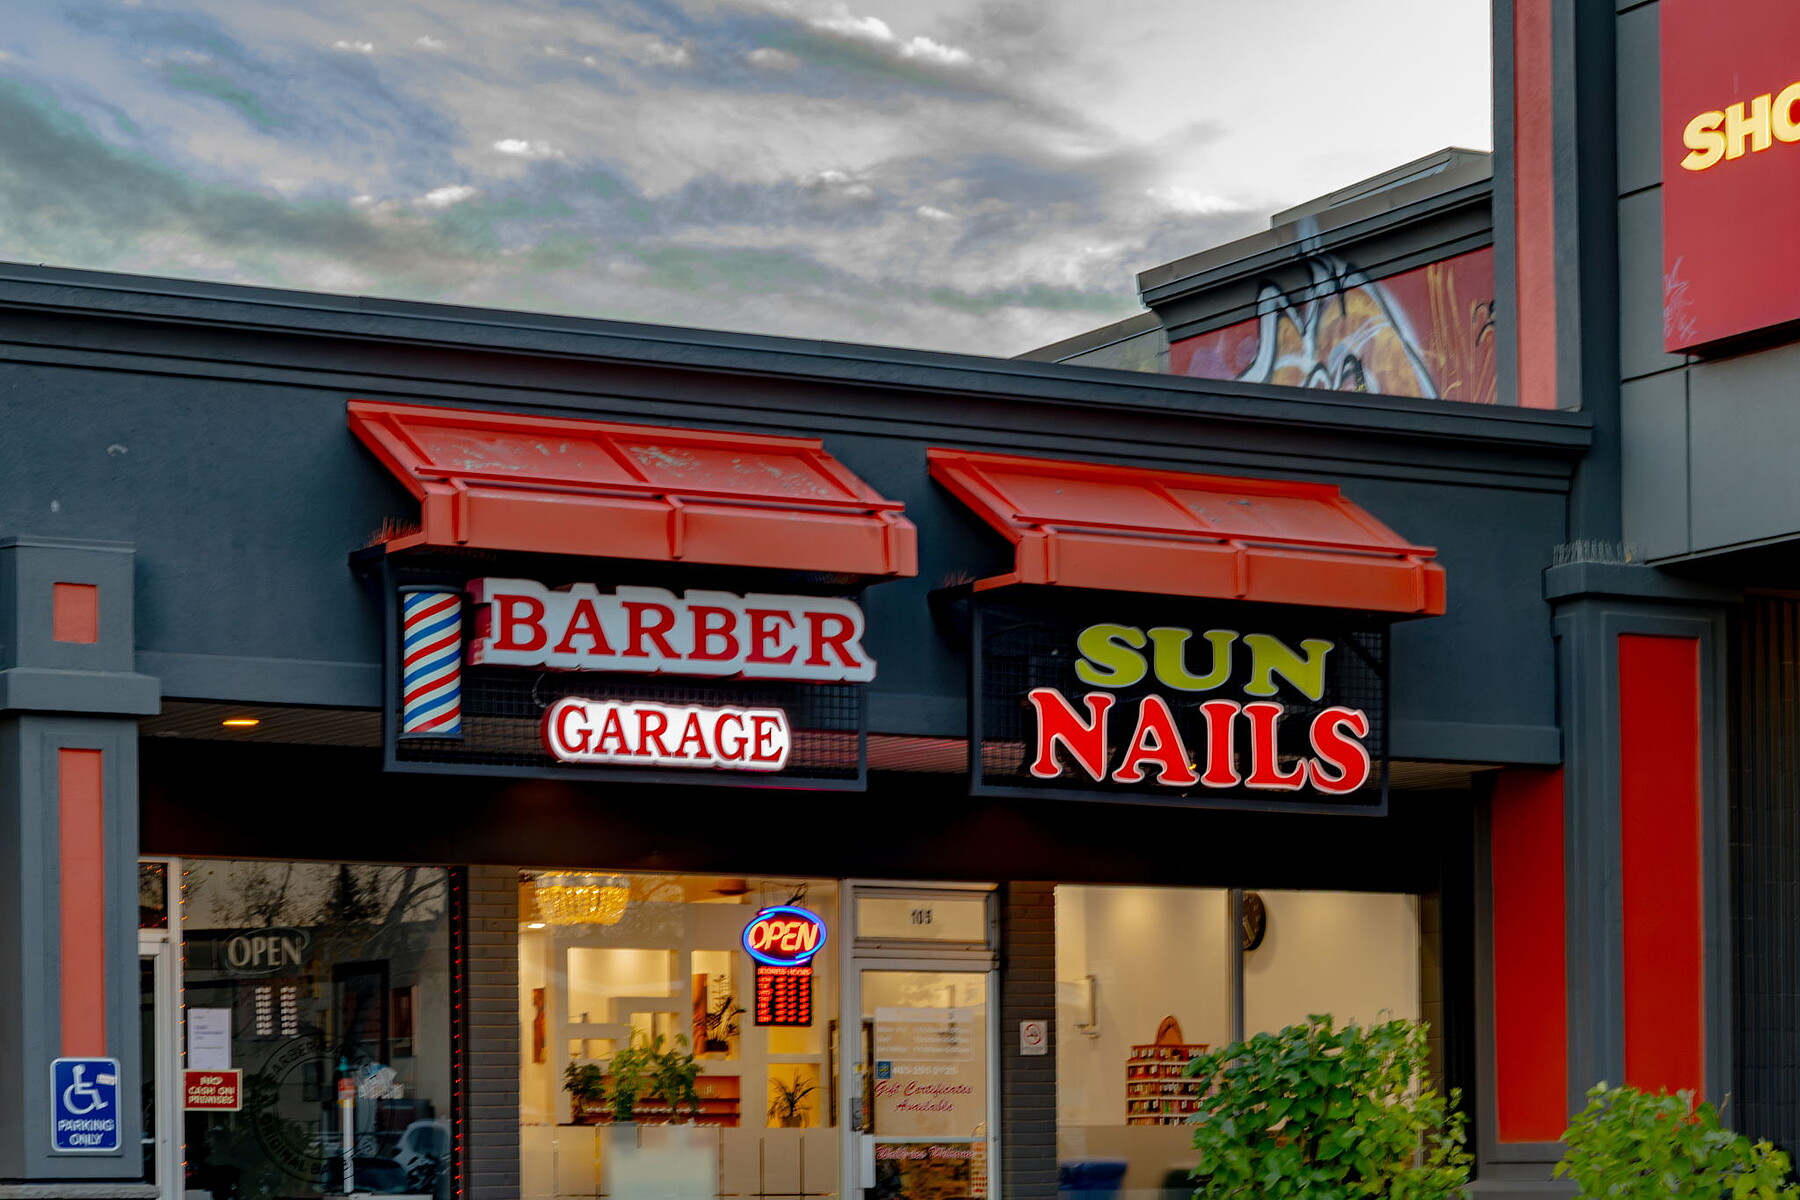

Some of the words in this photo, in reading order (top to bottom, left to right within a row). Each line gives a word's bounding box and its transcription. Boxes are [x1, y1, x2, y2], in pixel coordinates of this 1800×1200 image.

[492, 593, 862, 669] BARBER
[1075, 622, 1336, 701] SUN
[556, 704, 784, 762] GARAGE
[1028, 687, 1371, 794] NAILS
[749, 920, 819, 951] OPEN
[228, 936, 302, 967] OPEN
[200, 1076, 224, 1085] NO
[874, 1080, 900, 1098] Gift
[903, 1080, 973, 1098] Certificates
[188, 1086, 216, 1096] CASH
[217, 1086, 235, 1096] ON
[188, 1096, 235, 1105] PREMISES
[893, 1099, 954, 1113] Available
[58, 1119, 115, 1132] PARKING
[69, 1133, 104, 1146] ONLY
